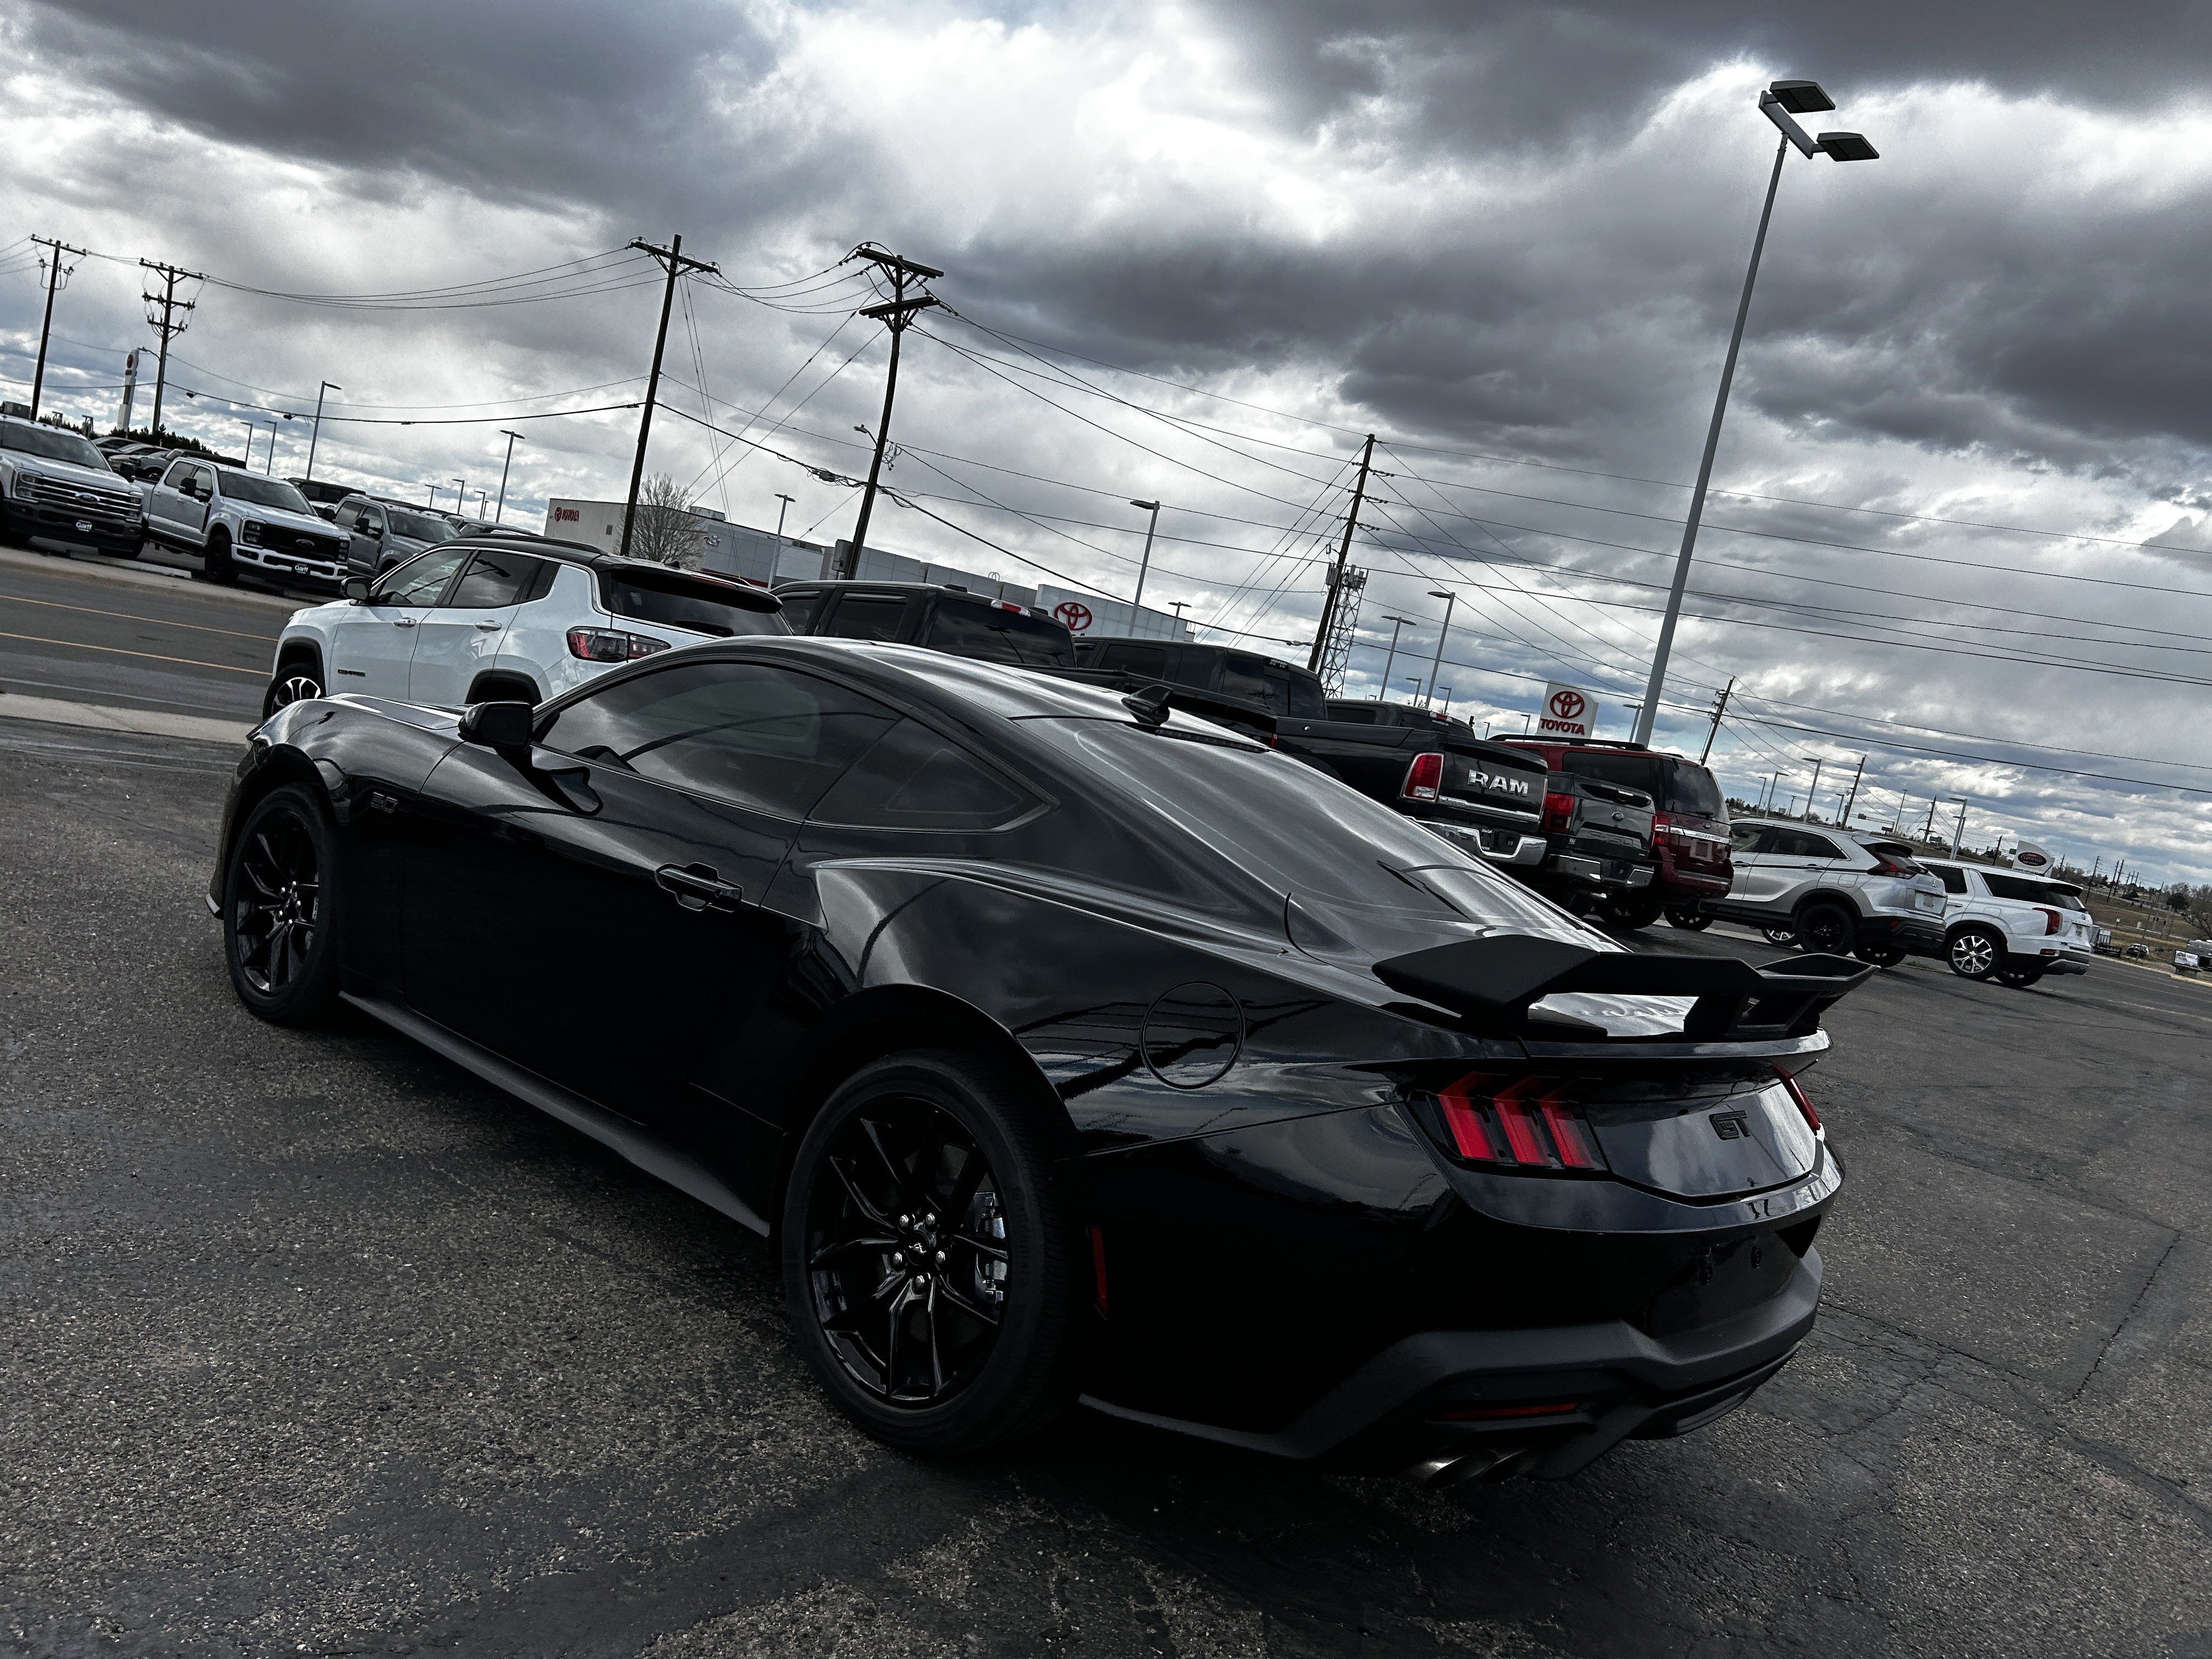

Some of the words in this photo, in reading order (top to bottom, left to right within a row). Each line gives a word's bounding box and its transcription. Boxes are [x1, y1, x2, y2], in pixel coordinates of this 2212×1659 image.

[1541, 718, 1584, 735] TOYOTA
[1468, 769, 1528, 797] RAM
[1709, 1110, 1751, 1141] GT
